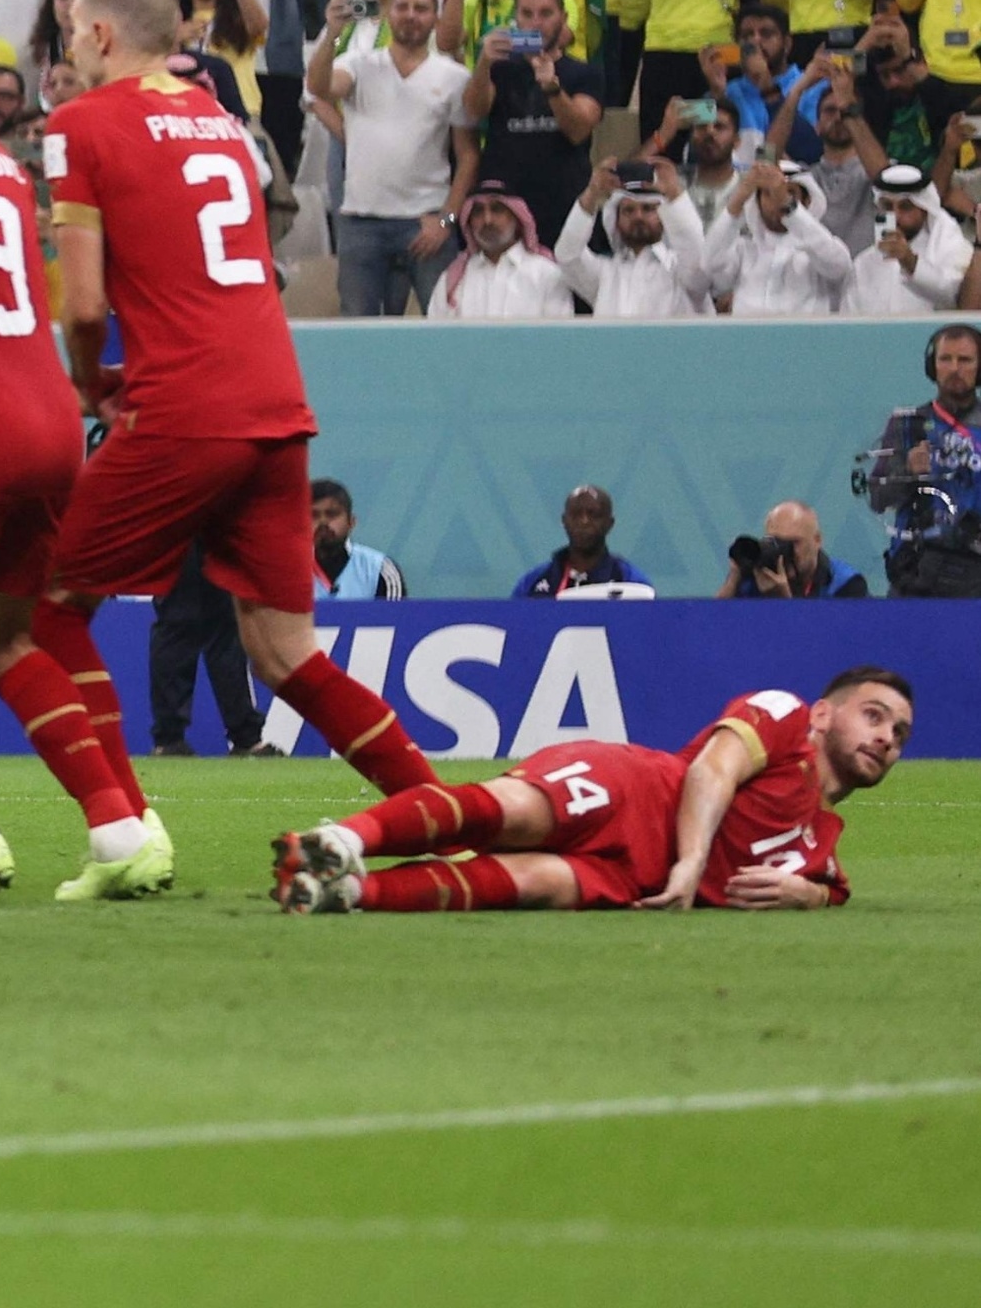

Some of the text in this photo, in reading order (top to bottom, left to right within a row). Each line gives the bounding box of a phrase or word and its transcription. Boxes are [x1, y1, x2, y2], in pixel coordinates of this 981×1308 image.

[506, 114, 558, 134] adida
[182, 152, 266, 286] 2
[540, 760, 609, 816] 14
